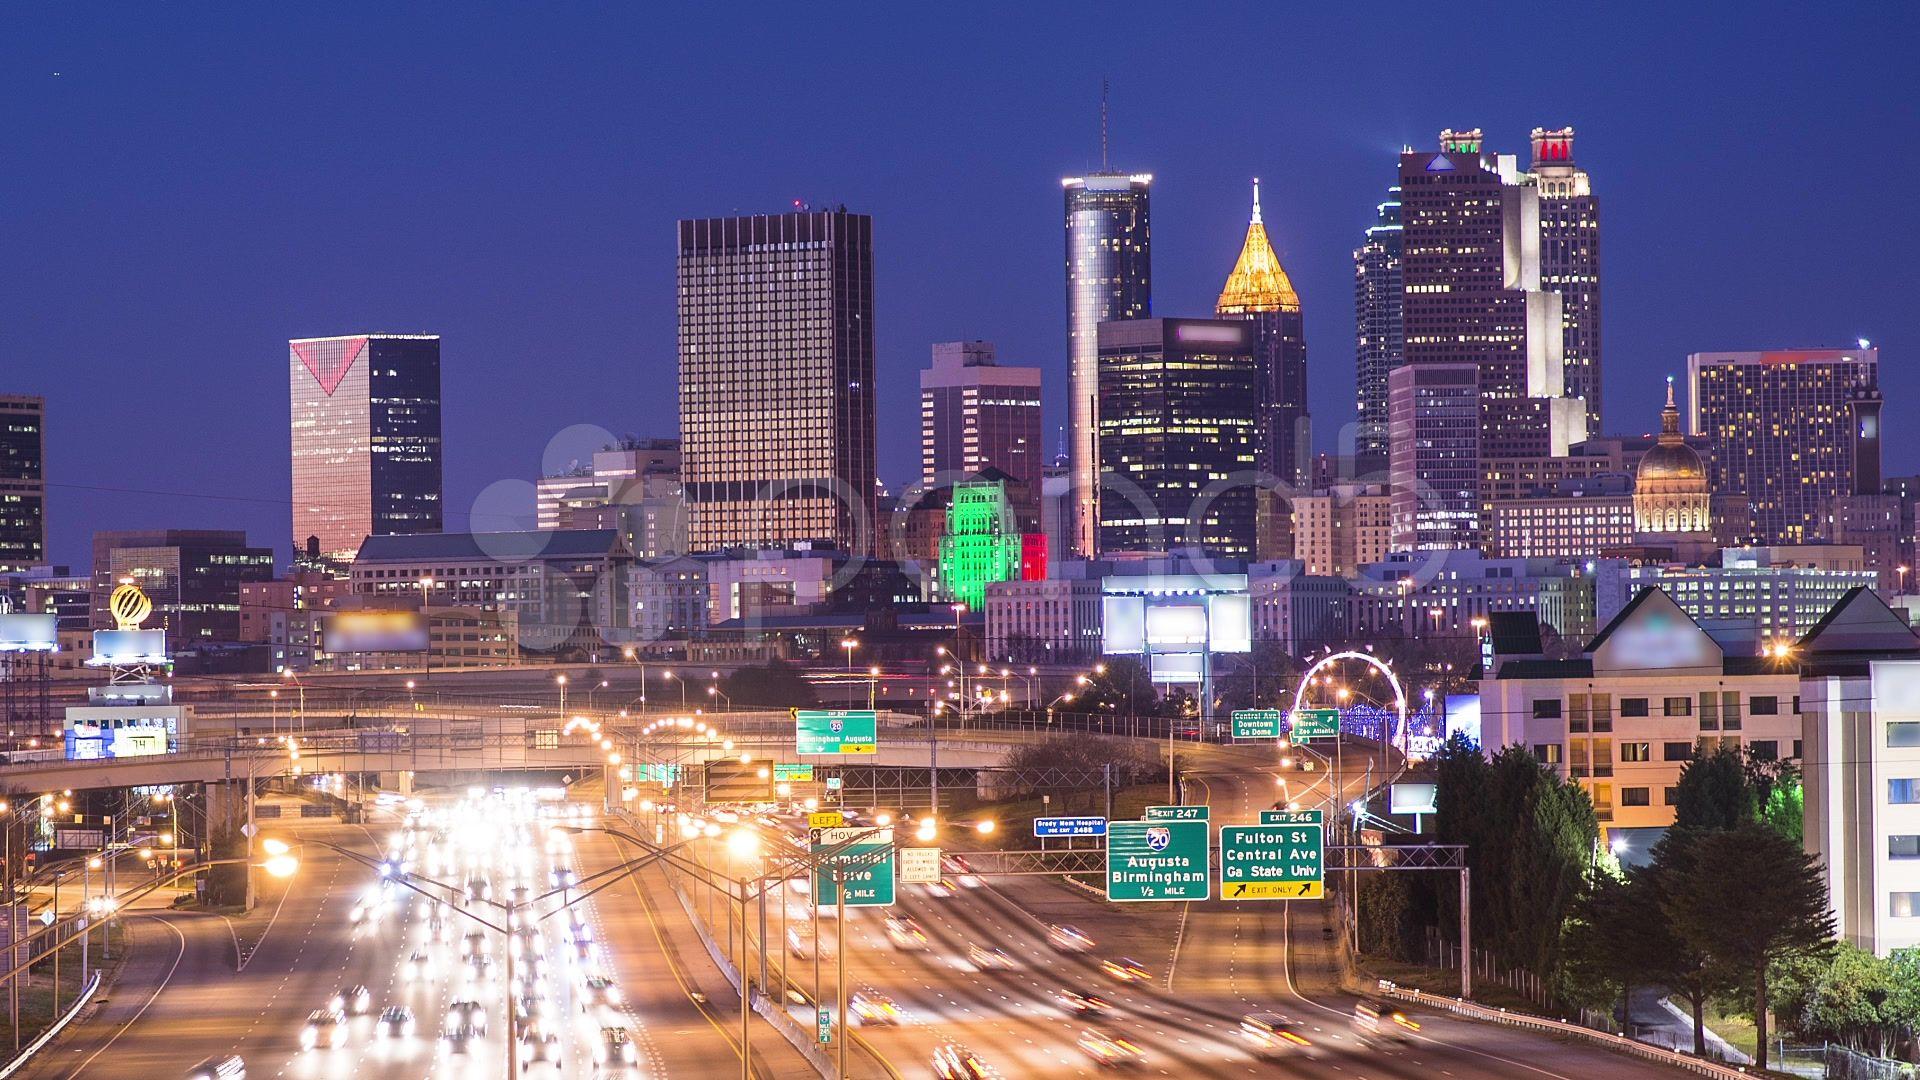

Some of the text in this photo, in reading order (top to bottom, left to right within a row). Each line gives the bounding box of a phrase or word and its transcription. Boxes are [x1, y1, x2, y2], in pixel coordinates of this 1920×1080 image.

[832, 723, 842, 731] 20
[844, 735, 873, 743] Augusta
[1176, 809, 1199, 818] 247
[1290, 813, 1313, 822] 246
[812, 816, 838, 825] LEFT
[1037, 820, 1057, 828] Grady
[1076, 819, 1104, 827] Hospital
[830, 831, 854, 840] HOV
[1150, 833, 1168, 846] 20
[1235, 831, 1307, 844] Fulton St
[1226, 847, 1317, 861] Central Ave
[1127, 856, 1190, 871] Augusta
[1226, 865, 1317, 878] Ga State Univ
[1112, 870, 1205, 886] Birmingham
[854, 889, 875, 898] MILE
[1164, 887, 1186, 895] MILE
[1272, 886, 1293, 894] ONLY
